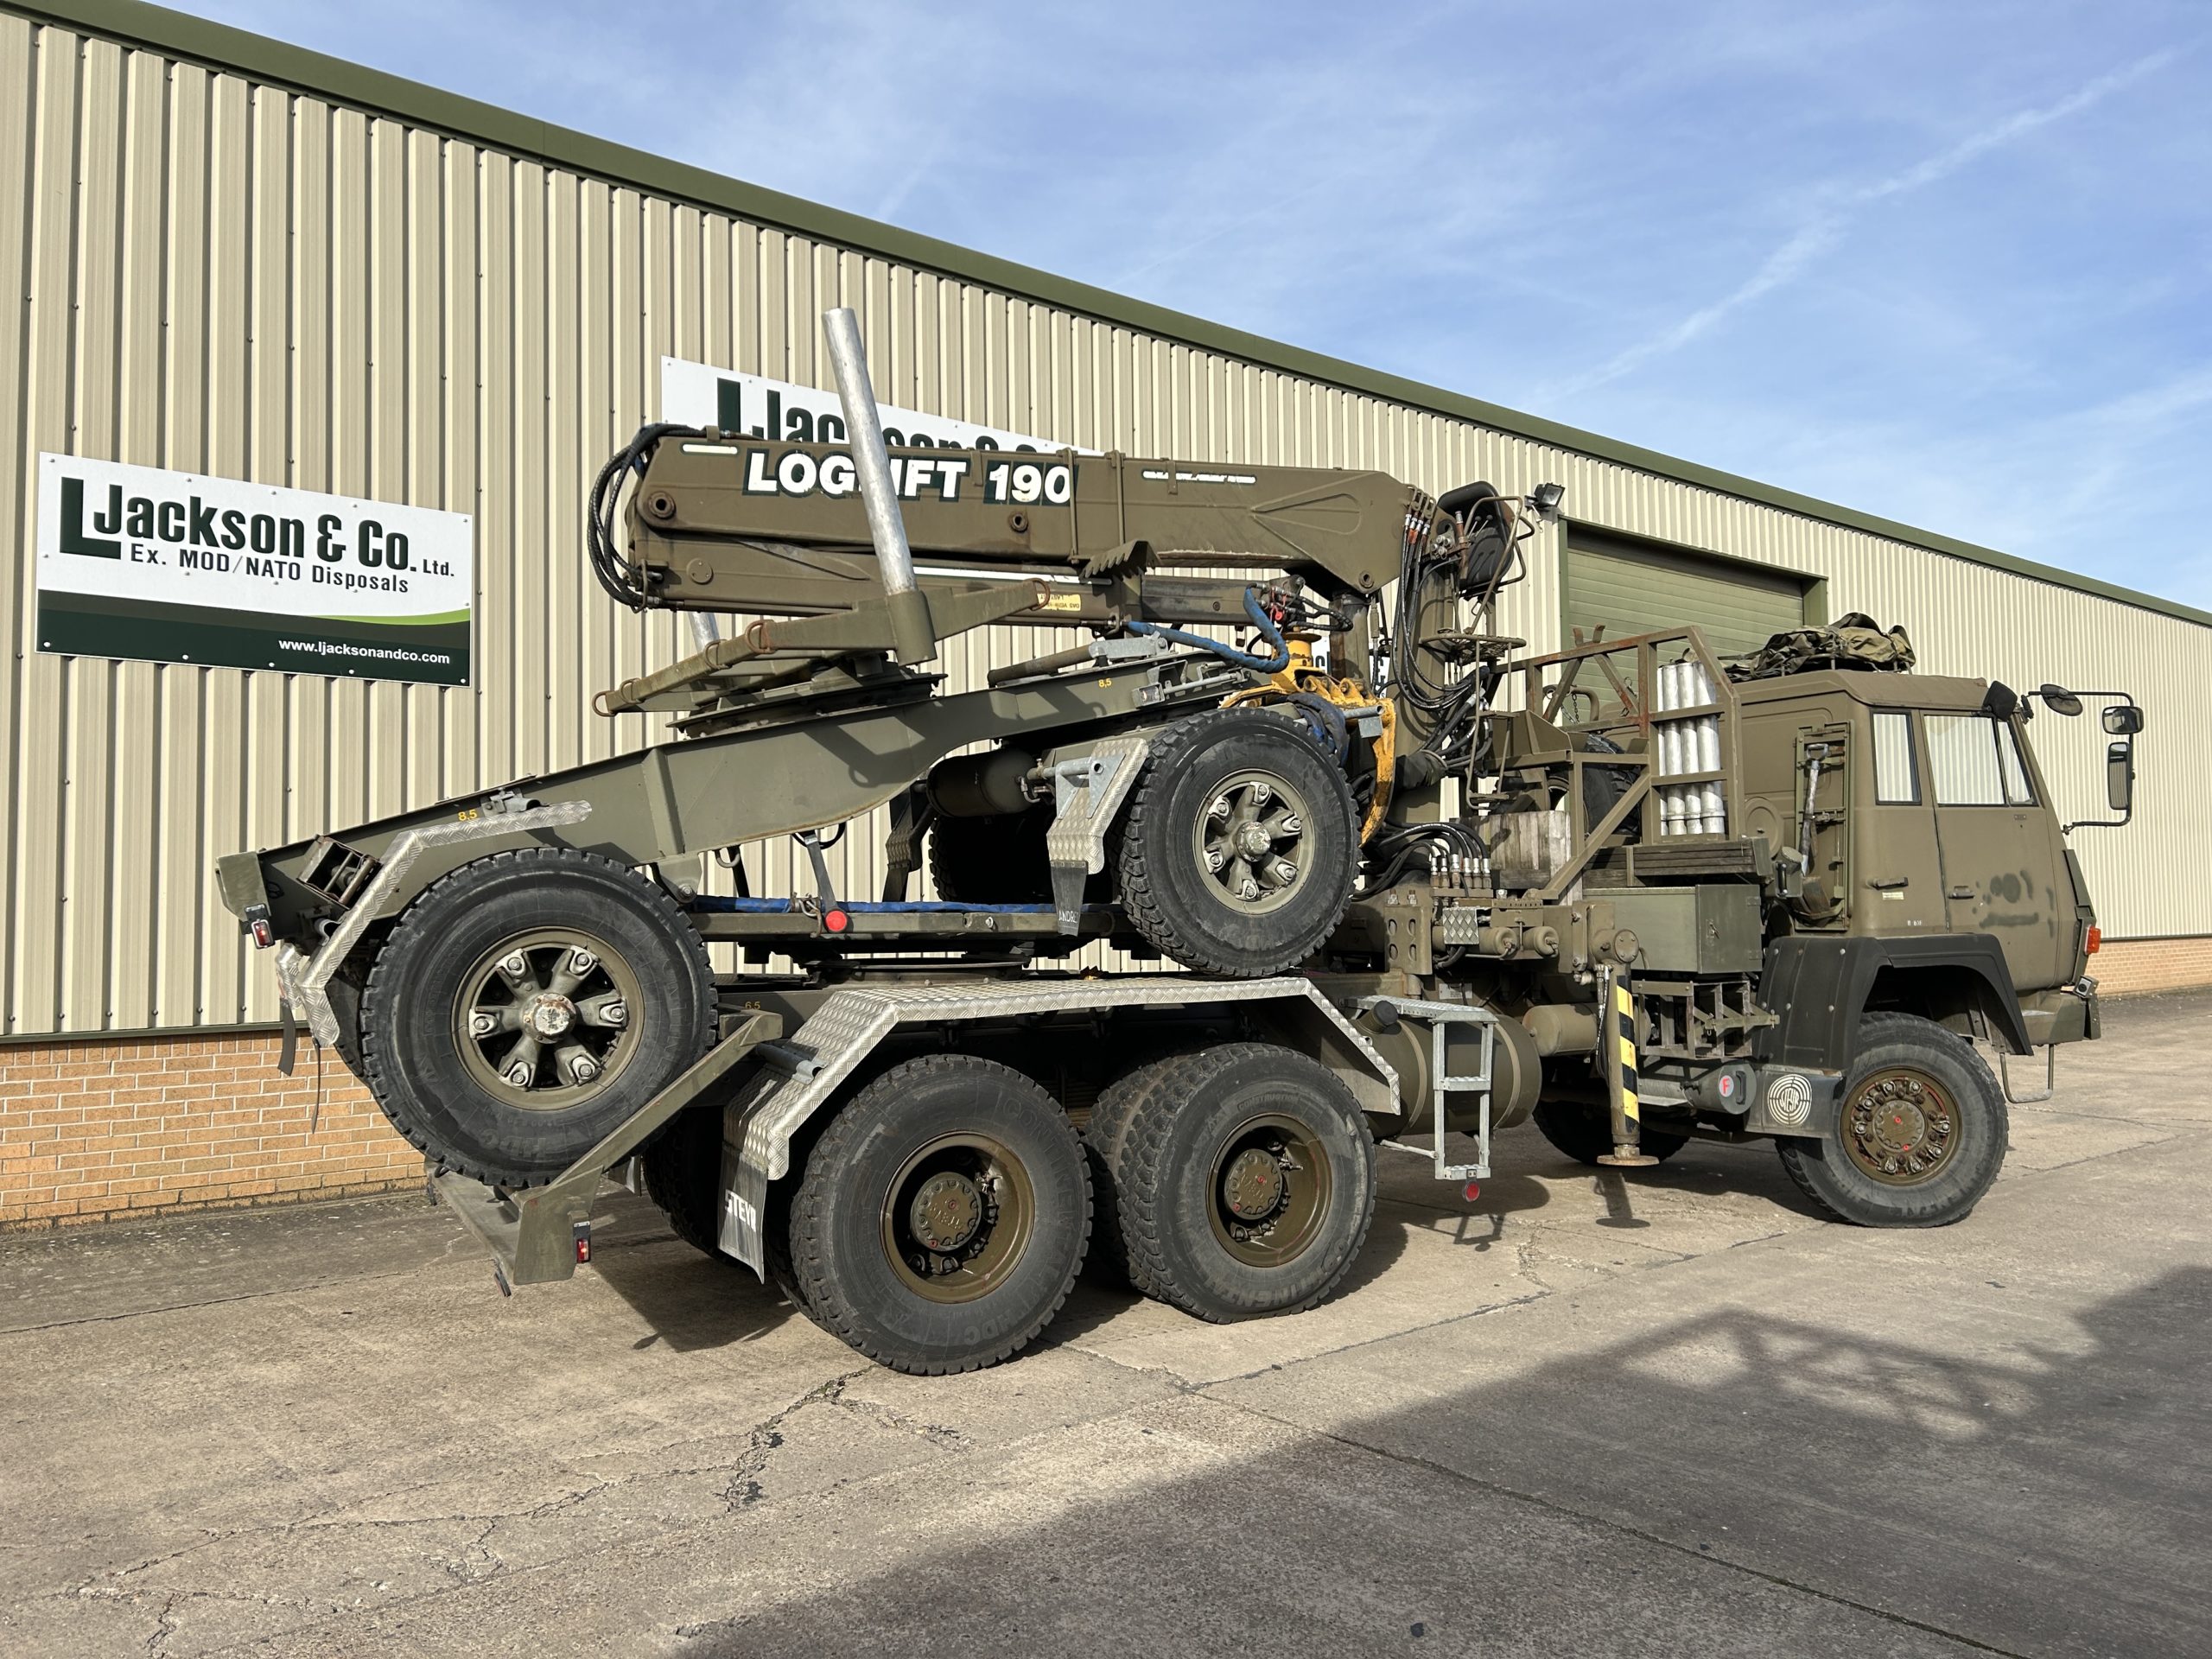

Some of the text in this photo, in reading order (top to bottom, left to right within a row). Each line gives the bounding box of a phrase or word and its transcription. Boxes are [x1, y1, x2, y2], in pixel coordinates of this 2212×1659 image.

[747, 451, 1071, 503] LOGIFT 190
[130, 543, 409, 593] Ex. MOD/NATO Disposals
[316, 514, 346, 563] &
[359, 519, 417, 572] Co.
[423, 558, 454, 577] Ltd.
[278, 638, 450, 664] www.ljacksonandco.com
[1722, 1077, 1731, 1094] F
